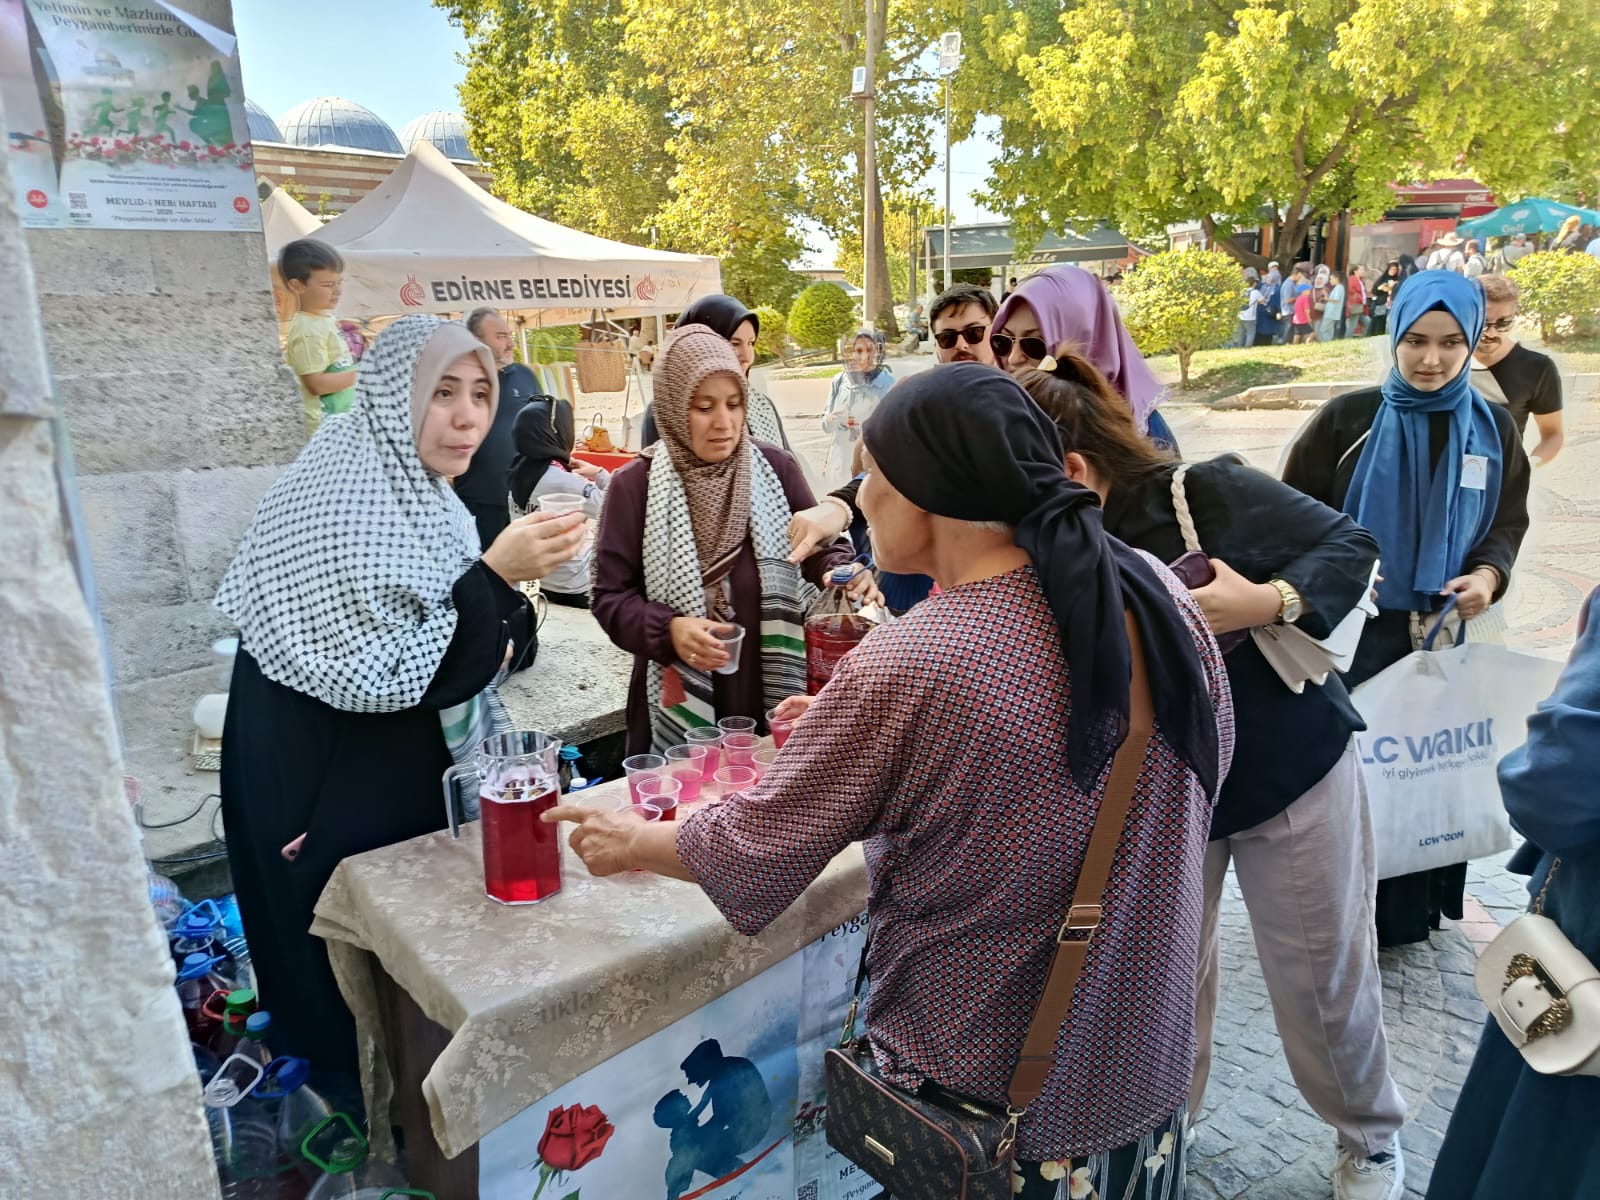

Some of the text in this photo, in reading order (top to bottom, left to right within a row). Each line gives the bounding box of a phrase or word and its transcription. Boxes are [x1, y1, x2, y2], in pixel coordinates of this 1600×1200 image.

[97, 8, 111, 18] ve
[52, 15, 174, 36] Peygamberimizle
[431, 273, 631, 302] EDİRNE BELEDİYESİ
[1357, 736, 1400, 764] LC
[1382, 767, 1395, 779] iyi
[821, 912, 870, 942] eyga
[839, 1163, 862, 1181] ME
